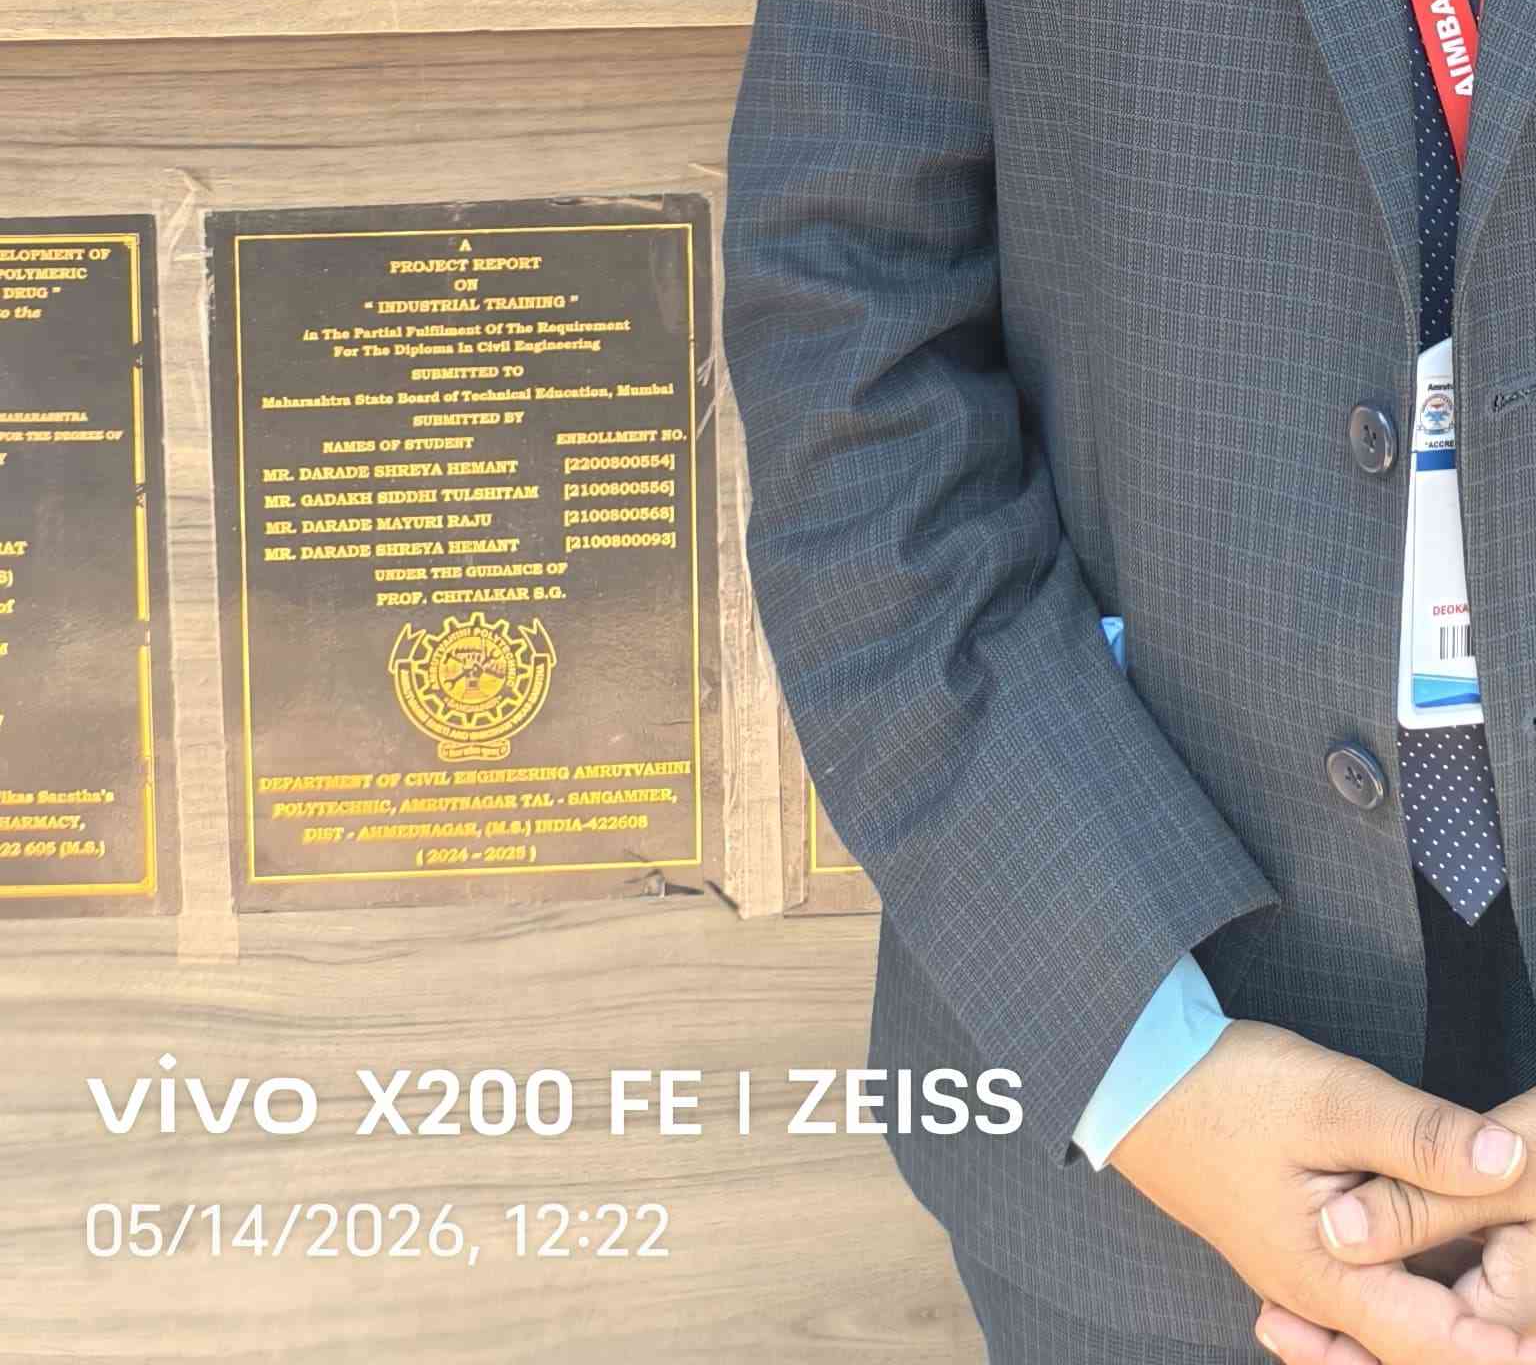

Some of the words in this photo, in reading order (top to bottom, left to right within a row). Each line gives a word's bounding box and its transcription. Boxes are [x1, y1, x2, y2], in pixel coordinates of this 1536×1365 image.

[88, 248, 112, 260] OF
[458, 238, 472, 252] A
[389, 259, 468, 273] PROJECT
[473, 257, 542, 271] REPORT
[454, 278, 479, 291] ON
[0, 308, 10, 319] o
[14, 305, 42, 319] the
[378, 298, 480, 314] INDUSTRIAL
[484, 295, 566, 311] TRAINING
[322, 328, 350, 340] The
[354, 326, 402, 339] Partial
[406, 325, 481, 338] Fulfilment
[486, 323, 503, 335] Of
[506, 323, 533, 334] The
[538, 320, 631, 336] Requirement
[333, 345, 359, 358] For
[362, 344, 391, 356] The
[395, 343, 453, 358] Diploma
[477, 340, 510, 353] Civil
[514, 338, 601, 353] Engineering
[411, 367, 499, 381] SUBMITTED
[502, 365, 524, 378] TO
[262, 395, 351, 409] Maharashtra
[355, 392, 394, 406] State
[398, 390, 440, 404] Board
[443, 390, 461, 403] of
[463, 388, 531, 401] Technical
[535, 386, 613, 400] Education,
[616, 383, 674, 397] Mumbai
[413, 413, 499, 427] SUBMITTED
[504, 411, 525, 424] BY
[322, 441, 375, 454] NAMES
[379, 439, 401, 452] OF
[404, 437, 475, 450] STUDENT
[556, 429, 657, 445] ENROLLMENT
[661, 429, 687, 442] NO.
[263, 469, 294, 482] MR.
[299, 465, 369, 481] DARADE
[374, 463, 443, 478] SHREYA
[447, 460, 518, 475] HEMANT
[264, 495, 296, 509] MR.
[301, 492, 373, 507] GADAKH
[377, 489, 437, 504] SIDDHI
[264, 521, 297, 535] MR.
[301, 518, 373, 534] DARADE
[376, 516, 444, 531] MAYURI
[447, 513, 493, 528] RAJU
[264, 547, 296, 561] MR.
[301, 544, 371, 560] DARADE
[375, 542, 444, 557] SHREYA
[448, 538, 520, 554] HEMANT
[374, 568, 428, 581] UNDER
[431, 566, 462, 579] THE
[466, 563, 543, 578] GUIDANCE
[546, 562, 568, 574] OF
[376, 592, 427, 606] PROF.
[432, 587, 529, 604] CHITALKAR
[533, 586, 567, 600] S.G.
[259, 774, 374, 792] DEPARTMENT
[376, 772, 401, 788] OF
[404, 771, 451, 787] CIVIL
[574, 761, 691, 780] AMRUTVAHINI
[520, 792, 554, 808] TAL
[567, 788, 678, 805] SANGAMNER,
[303, 826, 345, 843] DIST
